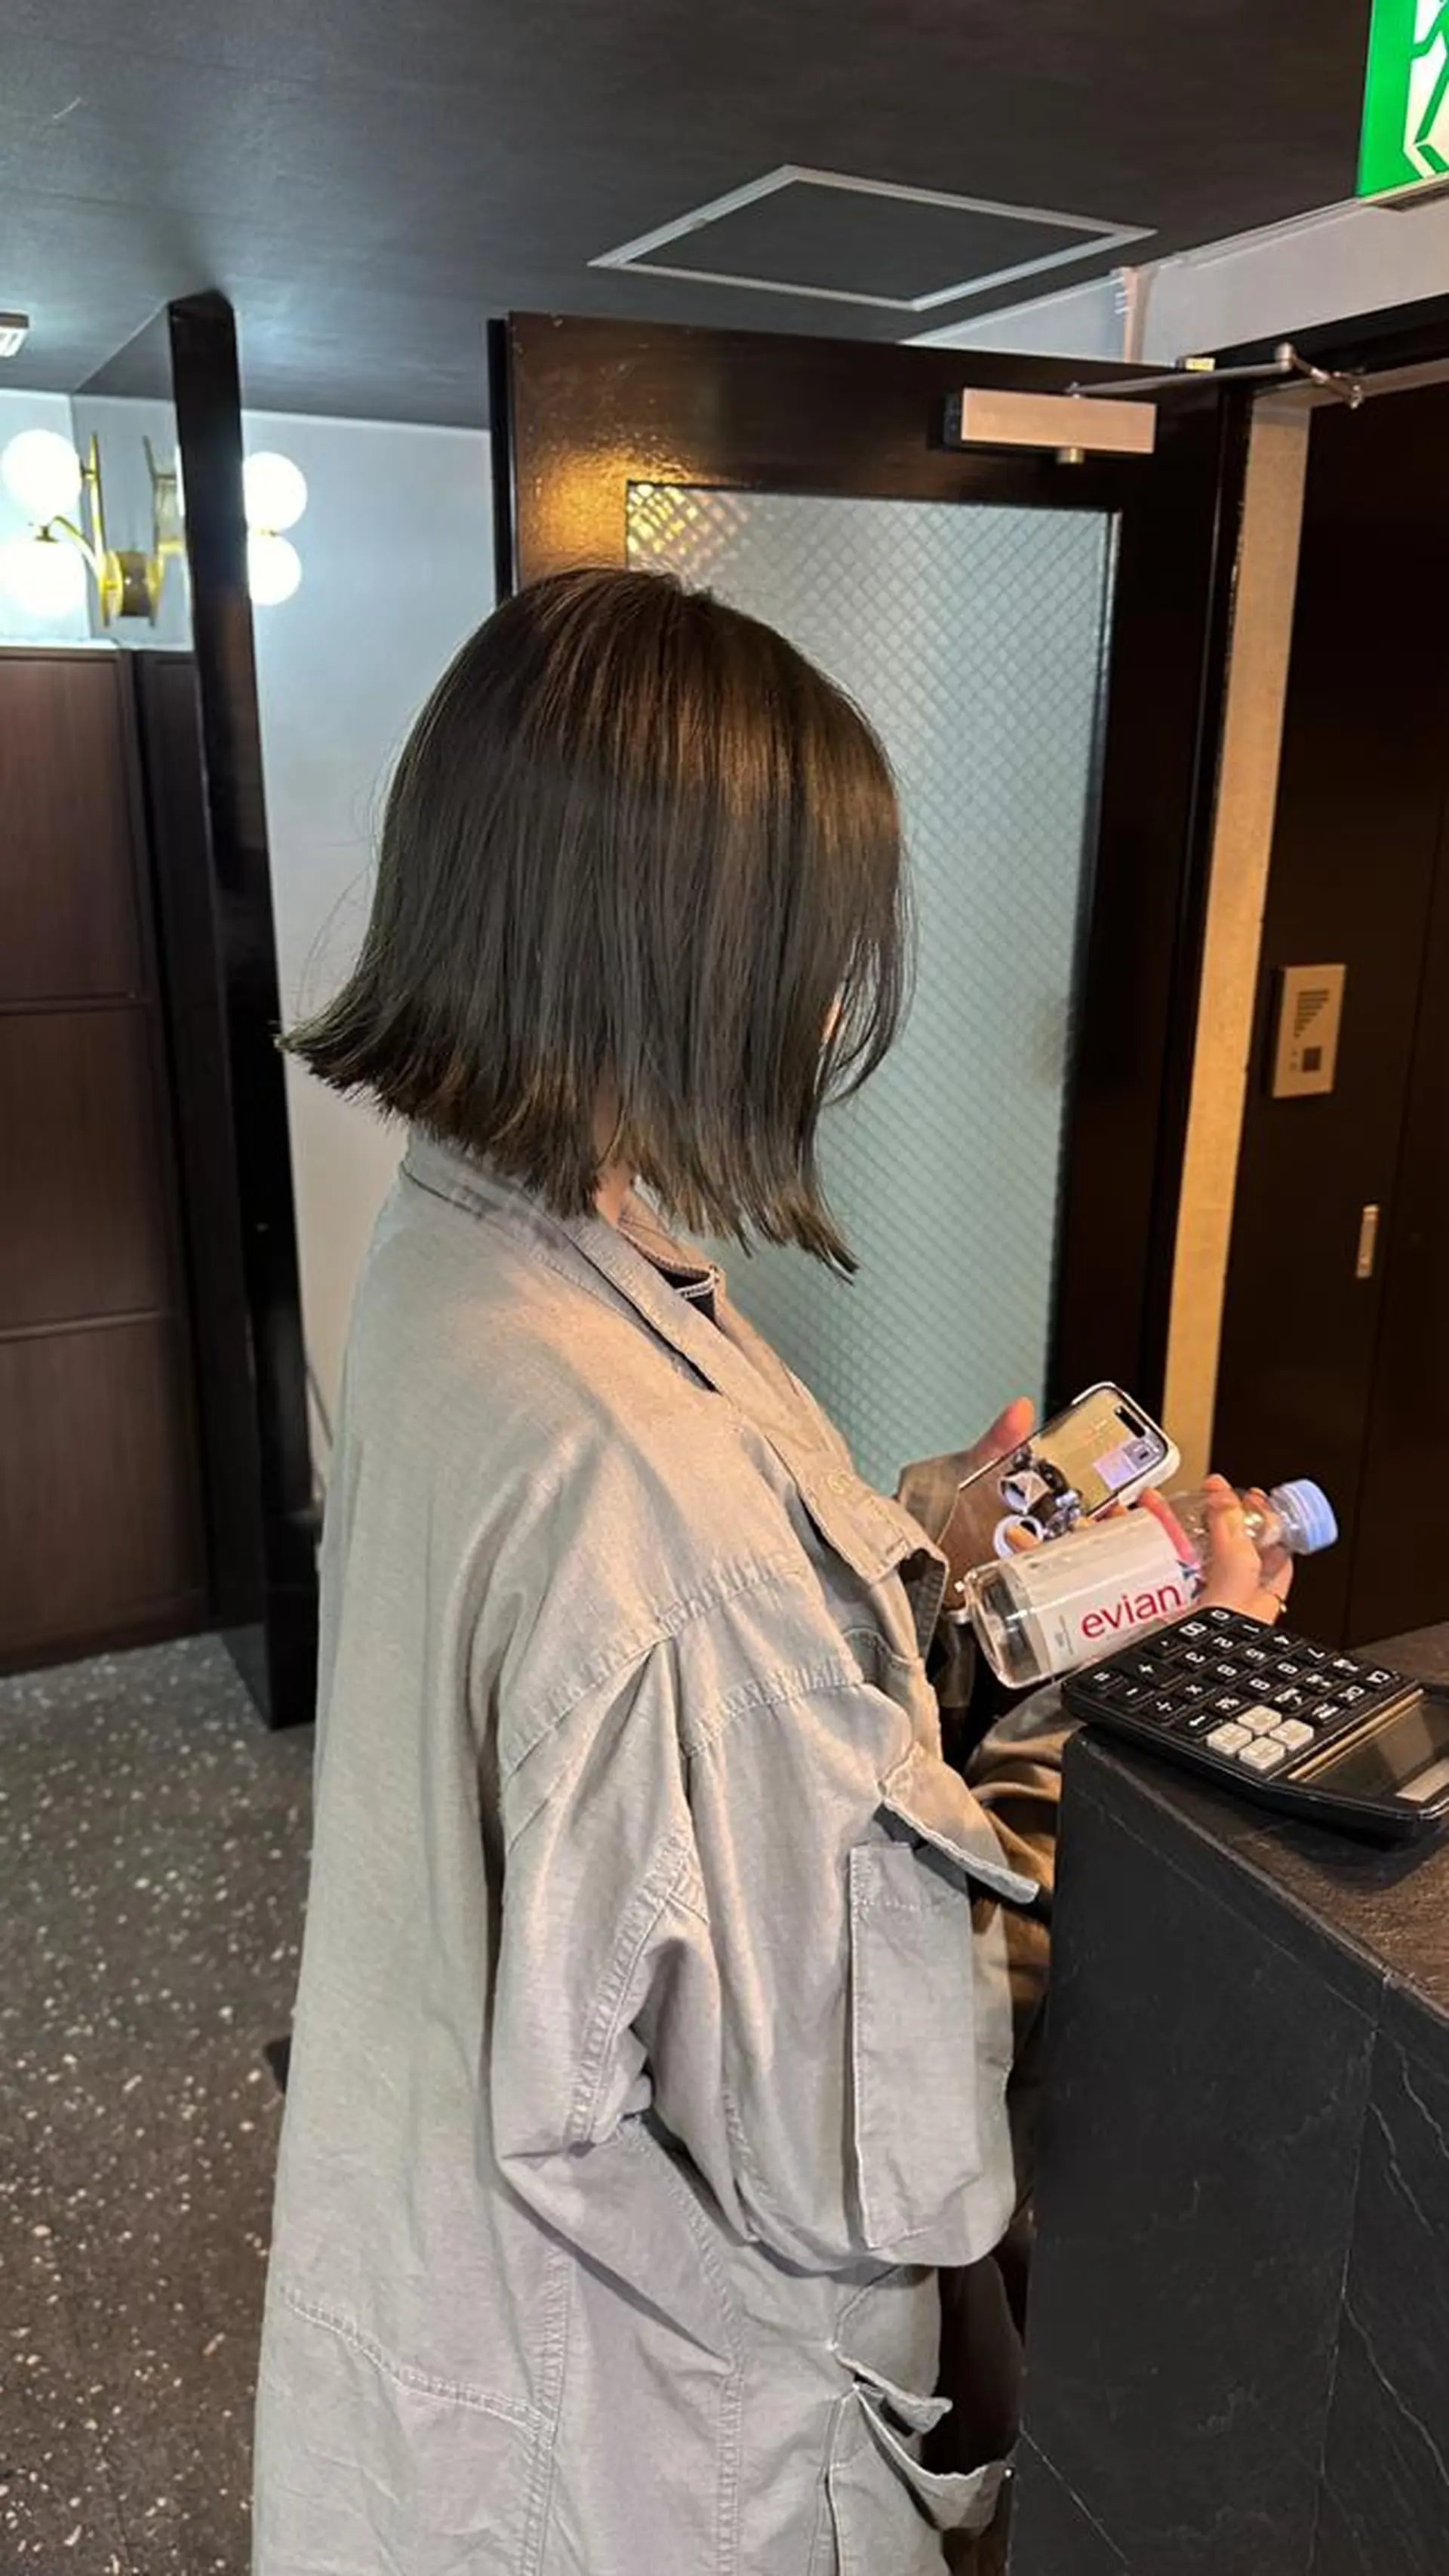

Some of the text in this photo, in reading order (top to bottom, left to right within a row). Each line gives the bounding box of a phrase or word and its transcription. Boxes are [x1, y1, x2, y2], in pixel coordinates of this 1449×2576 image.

[1081, 1585, 1182, 1639] evian
[1213, 1636, 1233, 1648] 2
[1185, 1652, 1205, 1663] 3
[1307, 1648, 1325, 1659] 7
